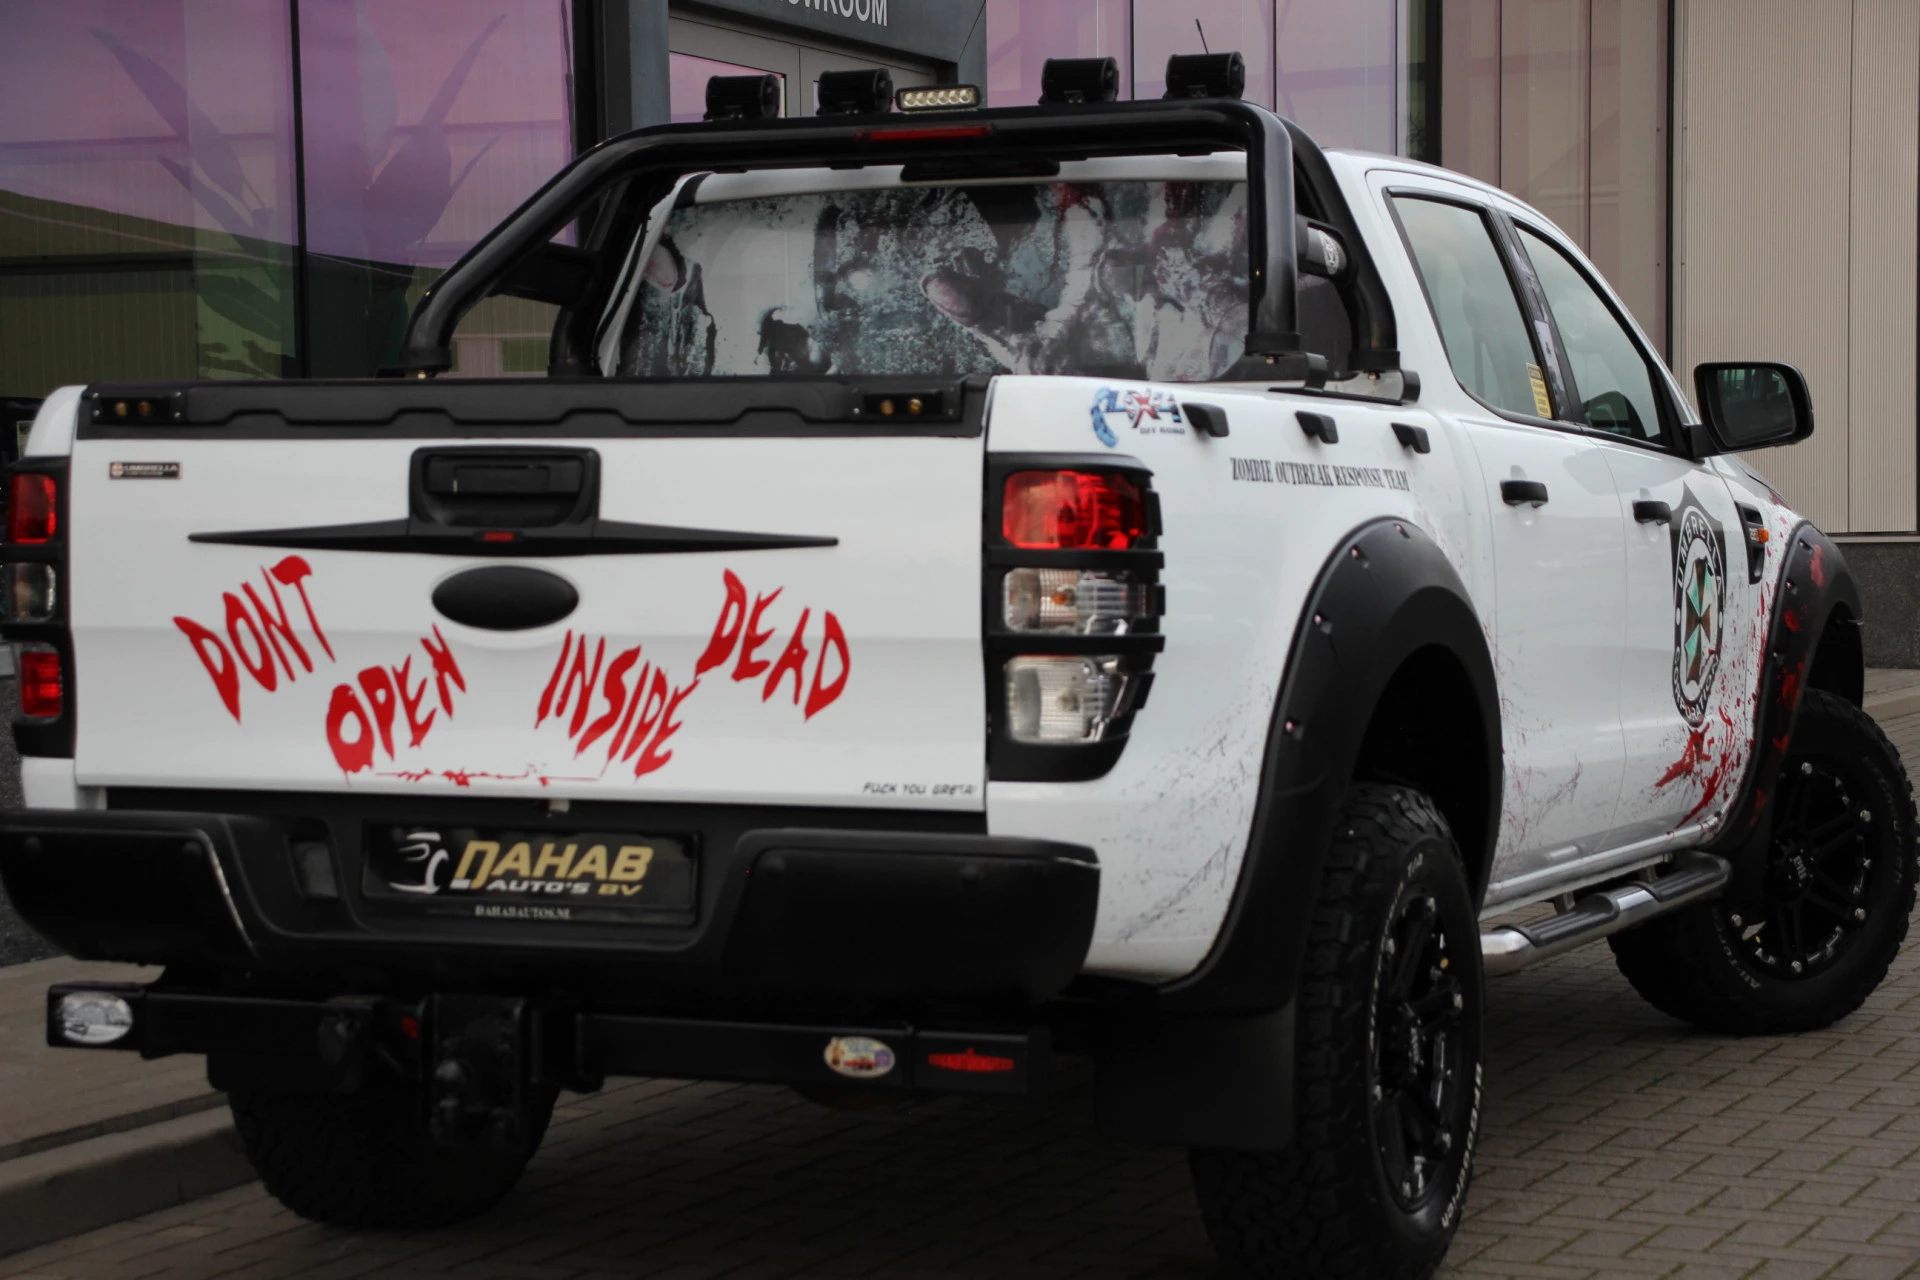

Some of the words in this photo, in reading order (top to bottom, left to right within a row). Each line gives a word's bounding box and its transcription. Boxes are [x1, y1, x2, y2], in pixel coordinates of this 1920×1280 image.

[1230, 457, 1274, 483] ZOMBIE
[1275, 461, 1334, 487] OUTBREAK
[1332, 464, 1386, 489] RESPONSE
[1383, 468, 1411, 492] TEAM
[1677, 515, 1722, 594] UMBRELLA
[172, 555, 336, 725] DONT
[325, 622, 466, 787] OPEN
[695, 567, 851, 724] DEAD
[533, 629, 701, 783] INSIDE
[863, 782, 898, 795] FUCK
[903, 783, 927, 795] YOU
[452, 840, 654, 889] DAHAB
[486, 879, 591, 895] AUTO'S
[597, 883, 643, 896] BV
